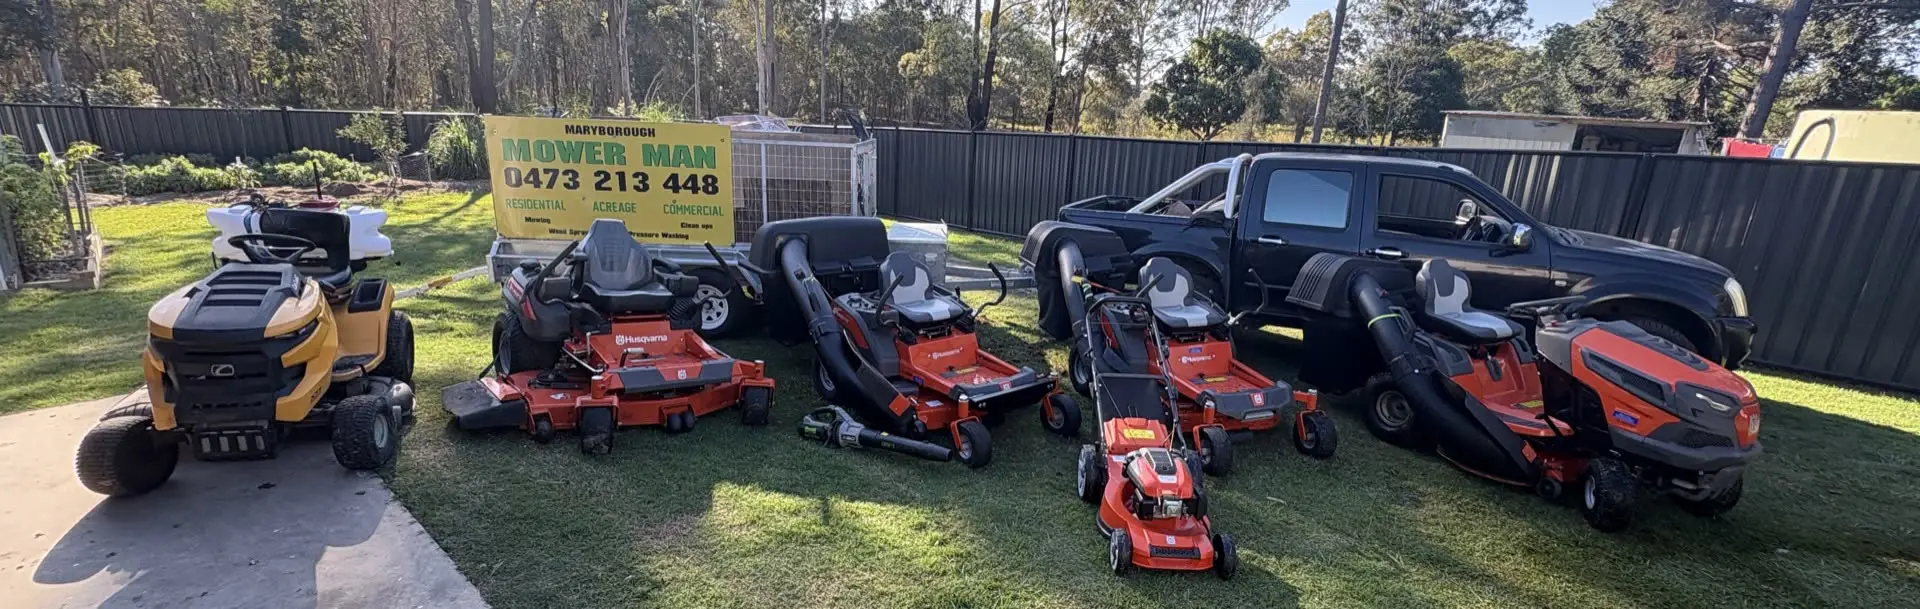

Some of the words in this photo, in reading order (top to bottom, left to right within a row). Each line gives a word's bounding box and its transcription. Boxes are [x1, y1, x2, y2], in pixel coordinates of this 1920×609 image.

[565, 124, 656, 138] MARYBOROUGH
[502, 138, 627, 166] MOWER
[642, 143, 717, 169] MAN
[504, 166, 580, 190] 0473
[594, 170, 650, 192] 213
[662, 173, 719, 195] 448
[505, 198, 566, 211] RESIDENTIAL
[592, 201, 637, 213] ACREAGE
[663, 204, 724, 216] COMMERCIAL
[524, 216, 551, 224] Mowing
[661, 232, 689, 240] Washing
[625, 334, 668, 344] Husqvarna
